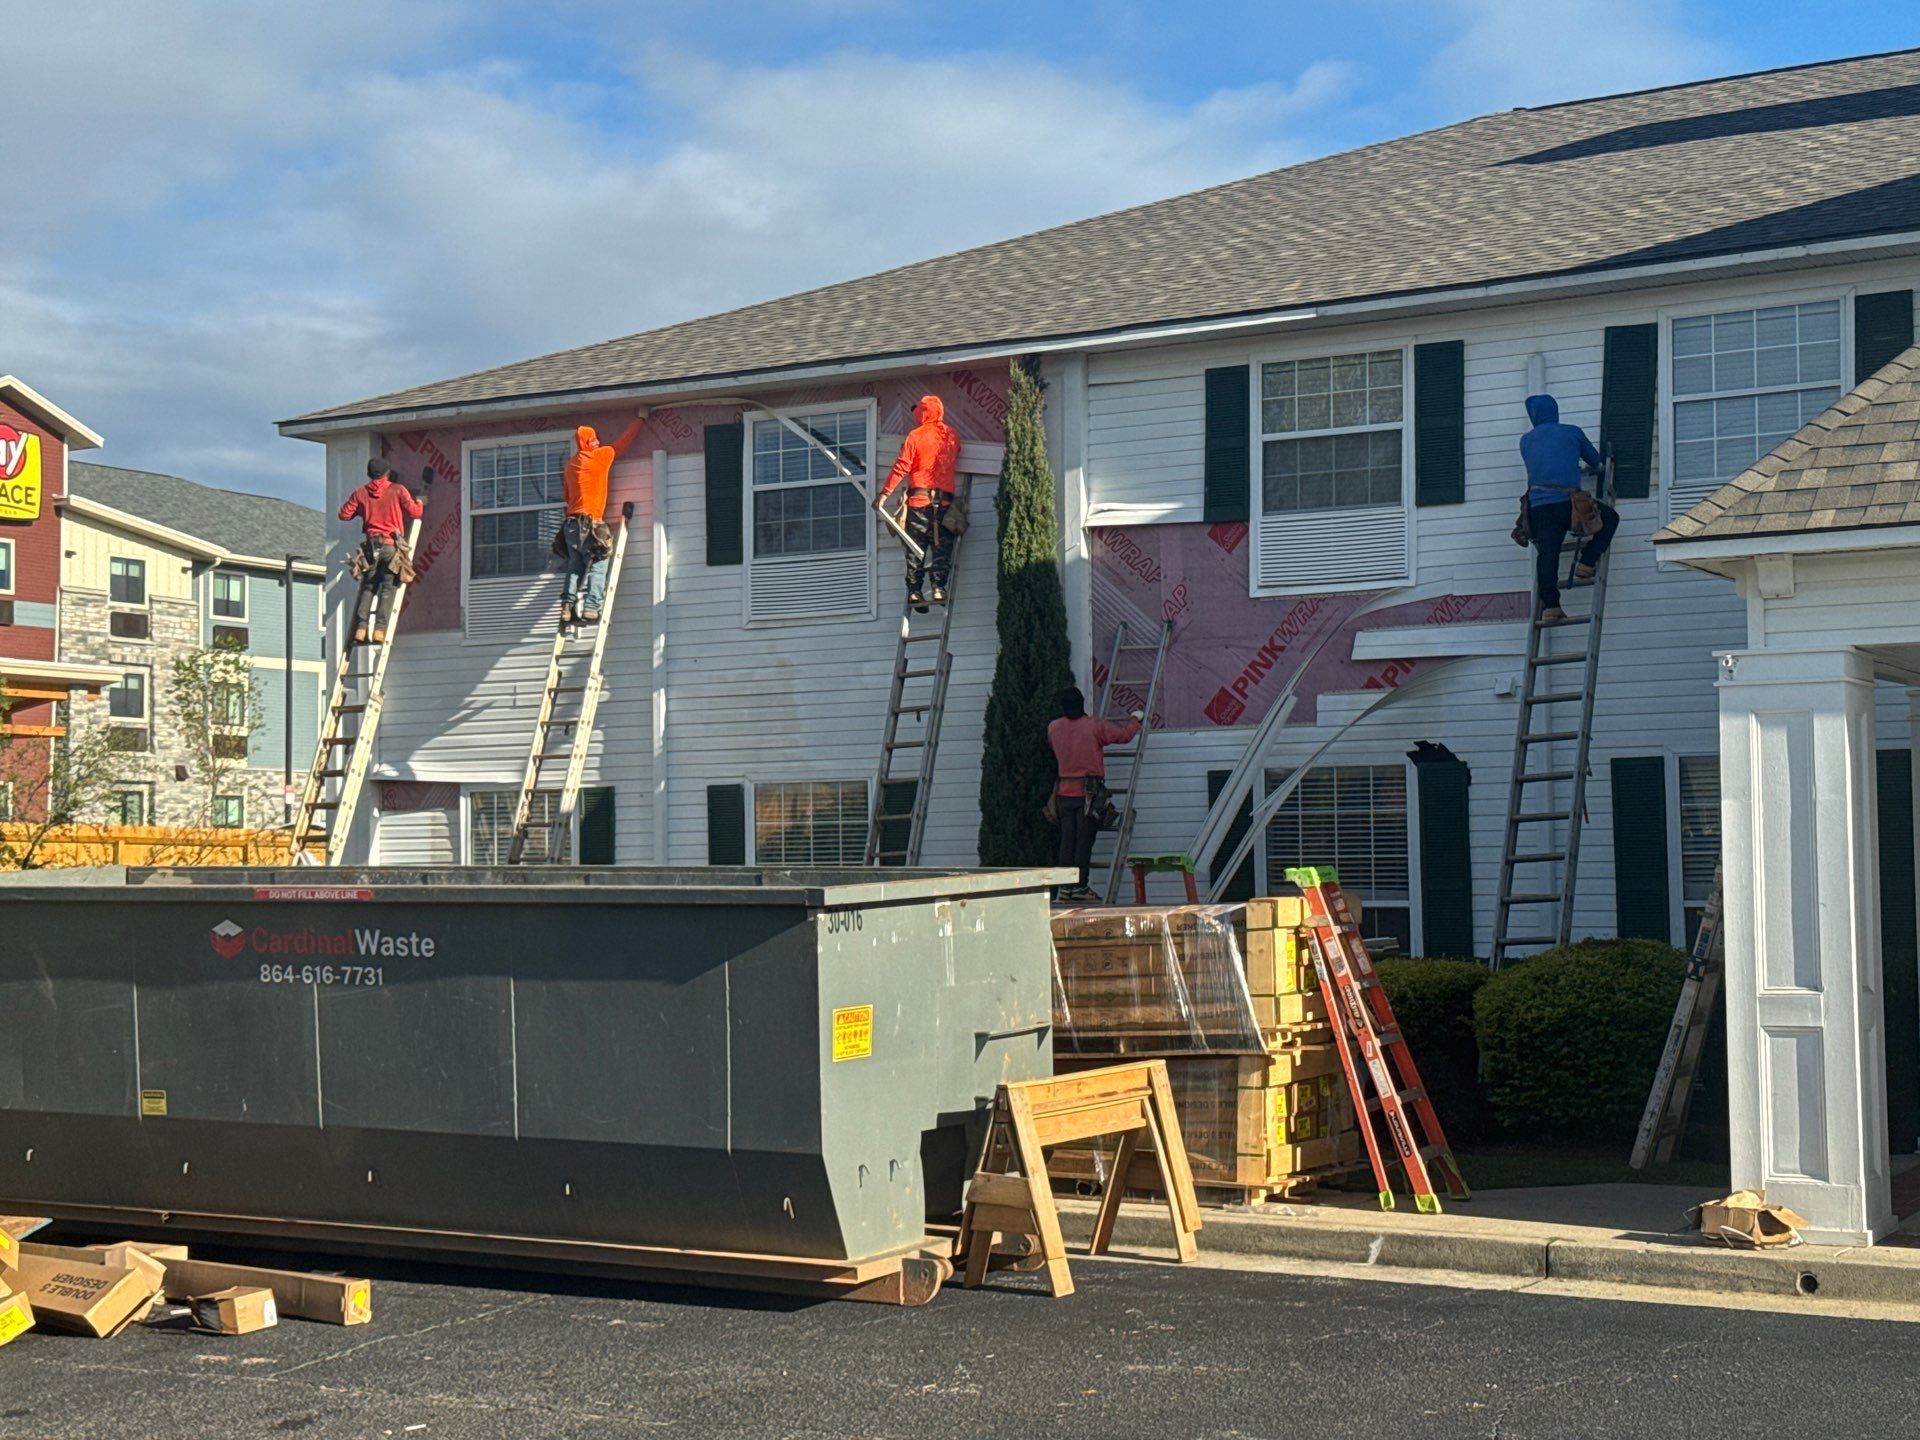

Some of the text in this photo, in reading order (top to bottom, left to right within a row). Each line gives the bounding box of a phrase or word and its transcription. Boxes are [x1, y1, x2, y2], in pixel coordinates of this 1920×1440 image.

[269, 889, 358, 899] DO NOT FILL ABOVE LINE
[260, 964, 384, 986] 864-616-7731
[52, 1272, 109, 1290] DESIGNER
[48, 1284, 96, 1300] DOUBLE
